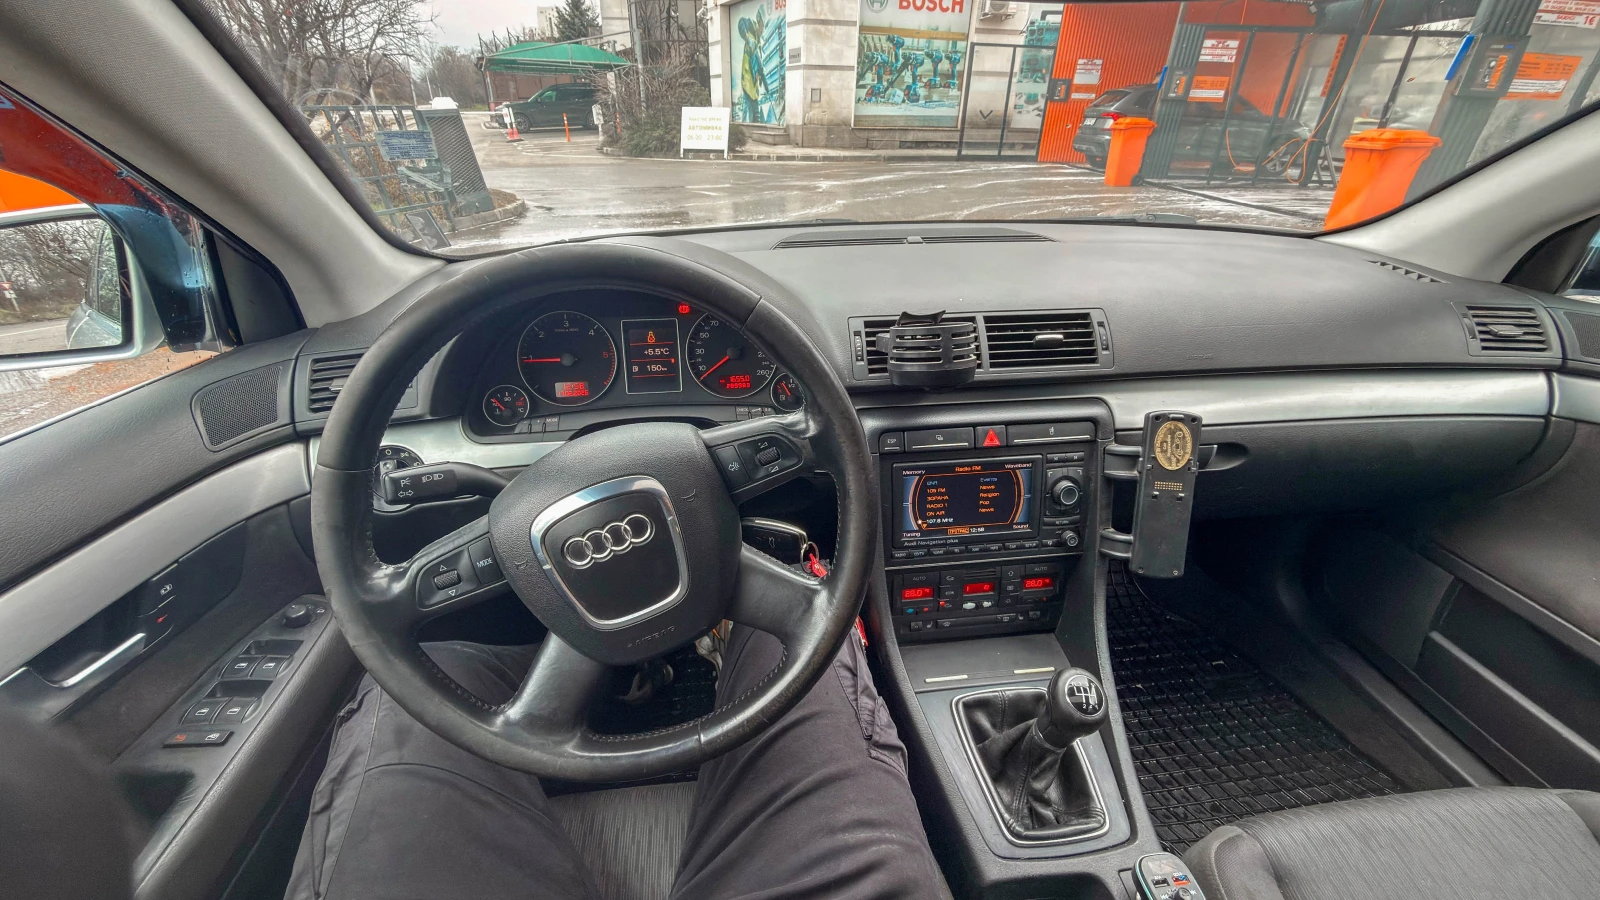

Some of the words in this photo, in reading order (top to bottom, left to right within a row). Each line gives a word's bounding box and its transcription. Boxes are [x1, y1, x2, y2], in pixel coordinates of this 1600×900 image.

[898, 0, 964, 13] BOSCH
[476, 557, 493, 568] MODE
[1025, 580, 1042, 588] 28.0
